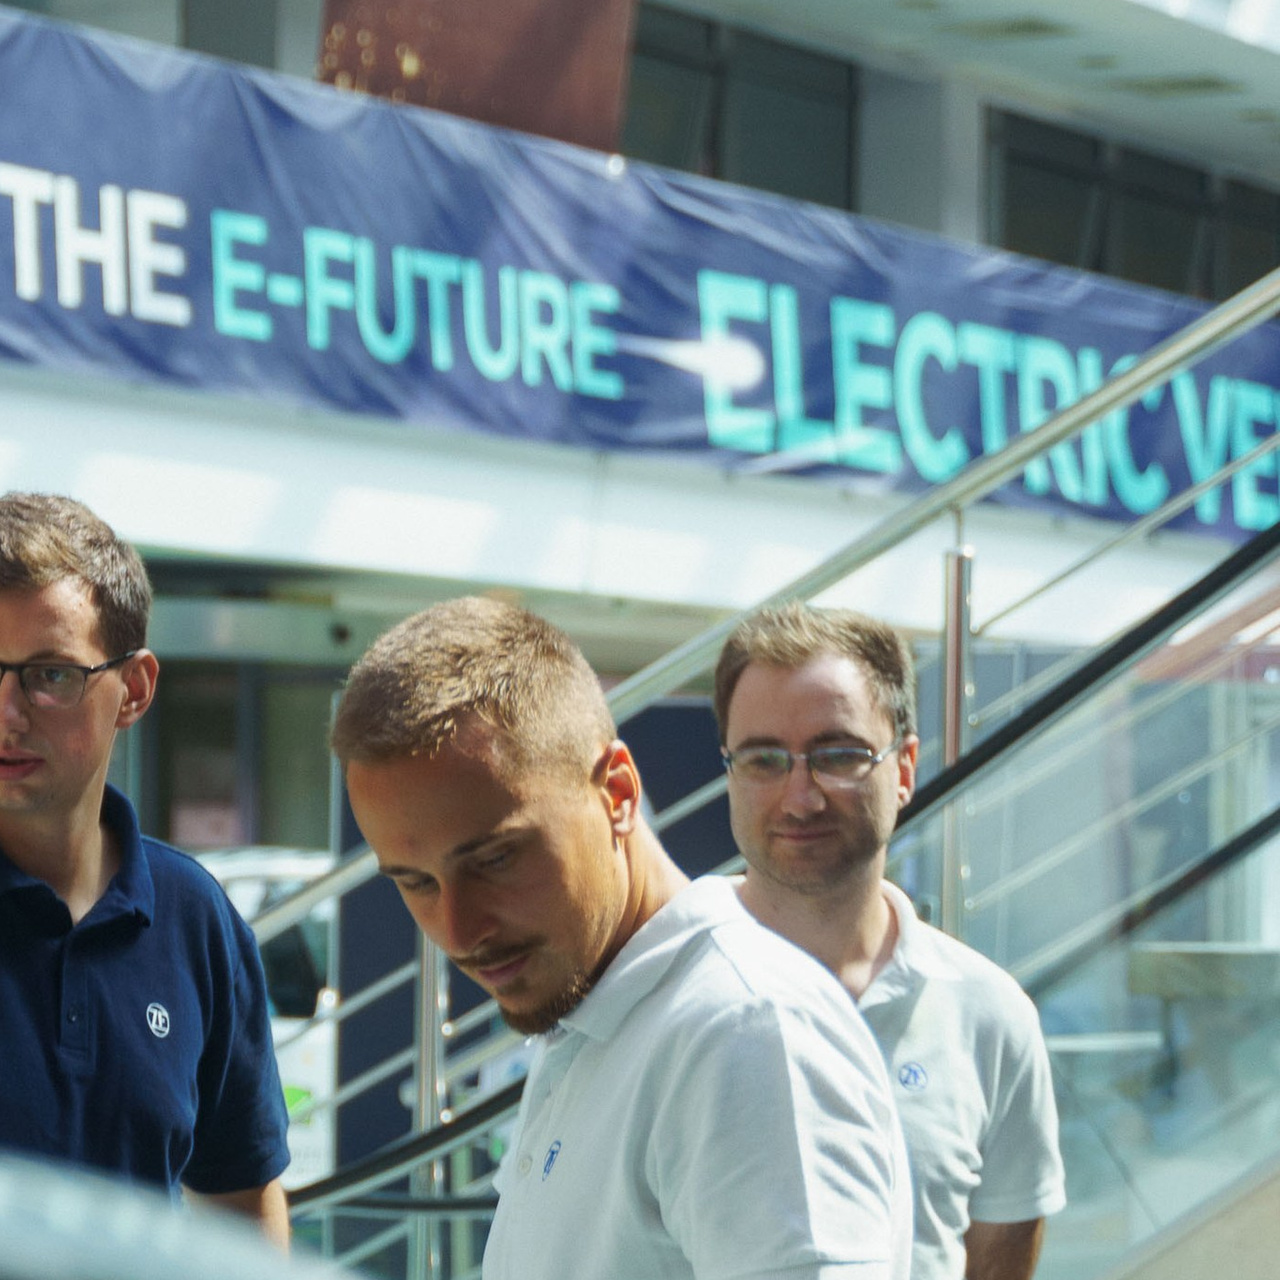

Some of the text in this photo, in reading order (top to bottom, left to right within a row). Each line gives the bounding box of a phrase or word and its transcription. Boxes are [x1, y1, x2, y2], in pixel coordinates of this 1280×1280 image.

[211, 208, 625, 400] E-FUTURE
[696, 268, 1280, 532] ELECTRIC VE
[147, 1005, 169, 1034] ZF
